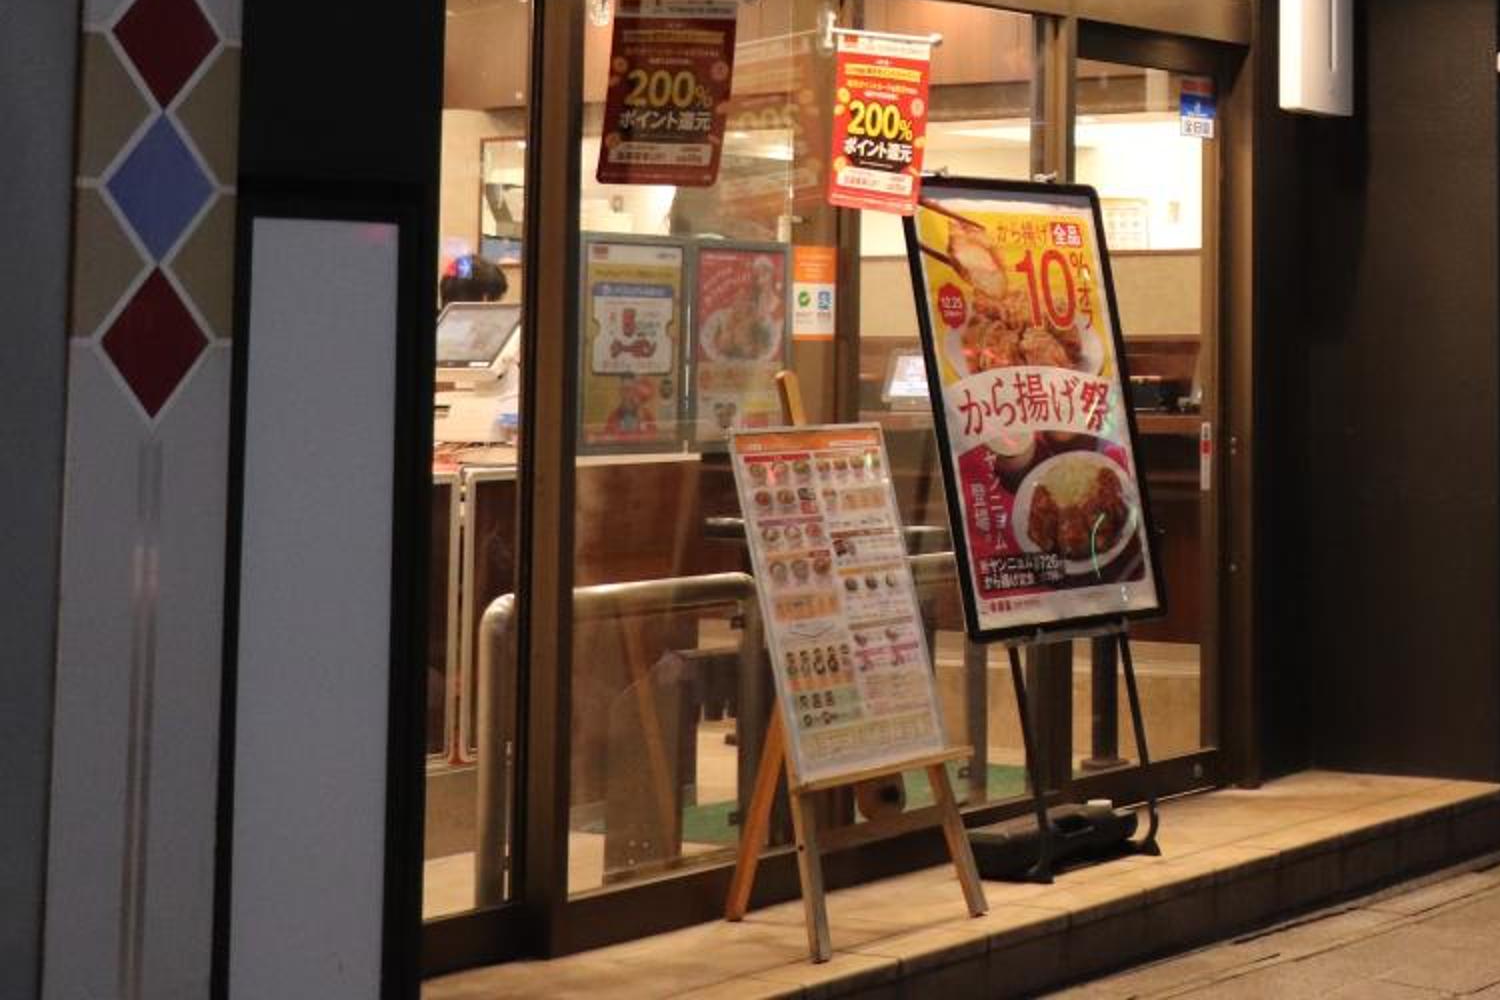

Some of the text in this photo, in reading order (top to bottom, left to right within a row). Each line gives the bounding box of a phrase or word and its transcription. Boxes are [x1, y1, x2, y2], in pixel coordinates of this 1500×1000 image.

[624, 69, 712, 108] 200%
[620, 111, 712, 131] ポイント還元
[847, 100, 913, 141] 200%
[844, 136, 913, 162] ポイント還元
[959, 373, 1109, 436] から揚げ祭
